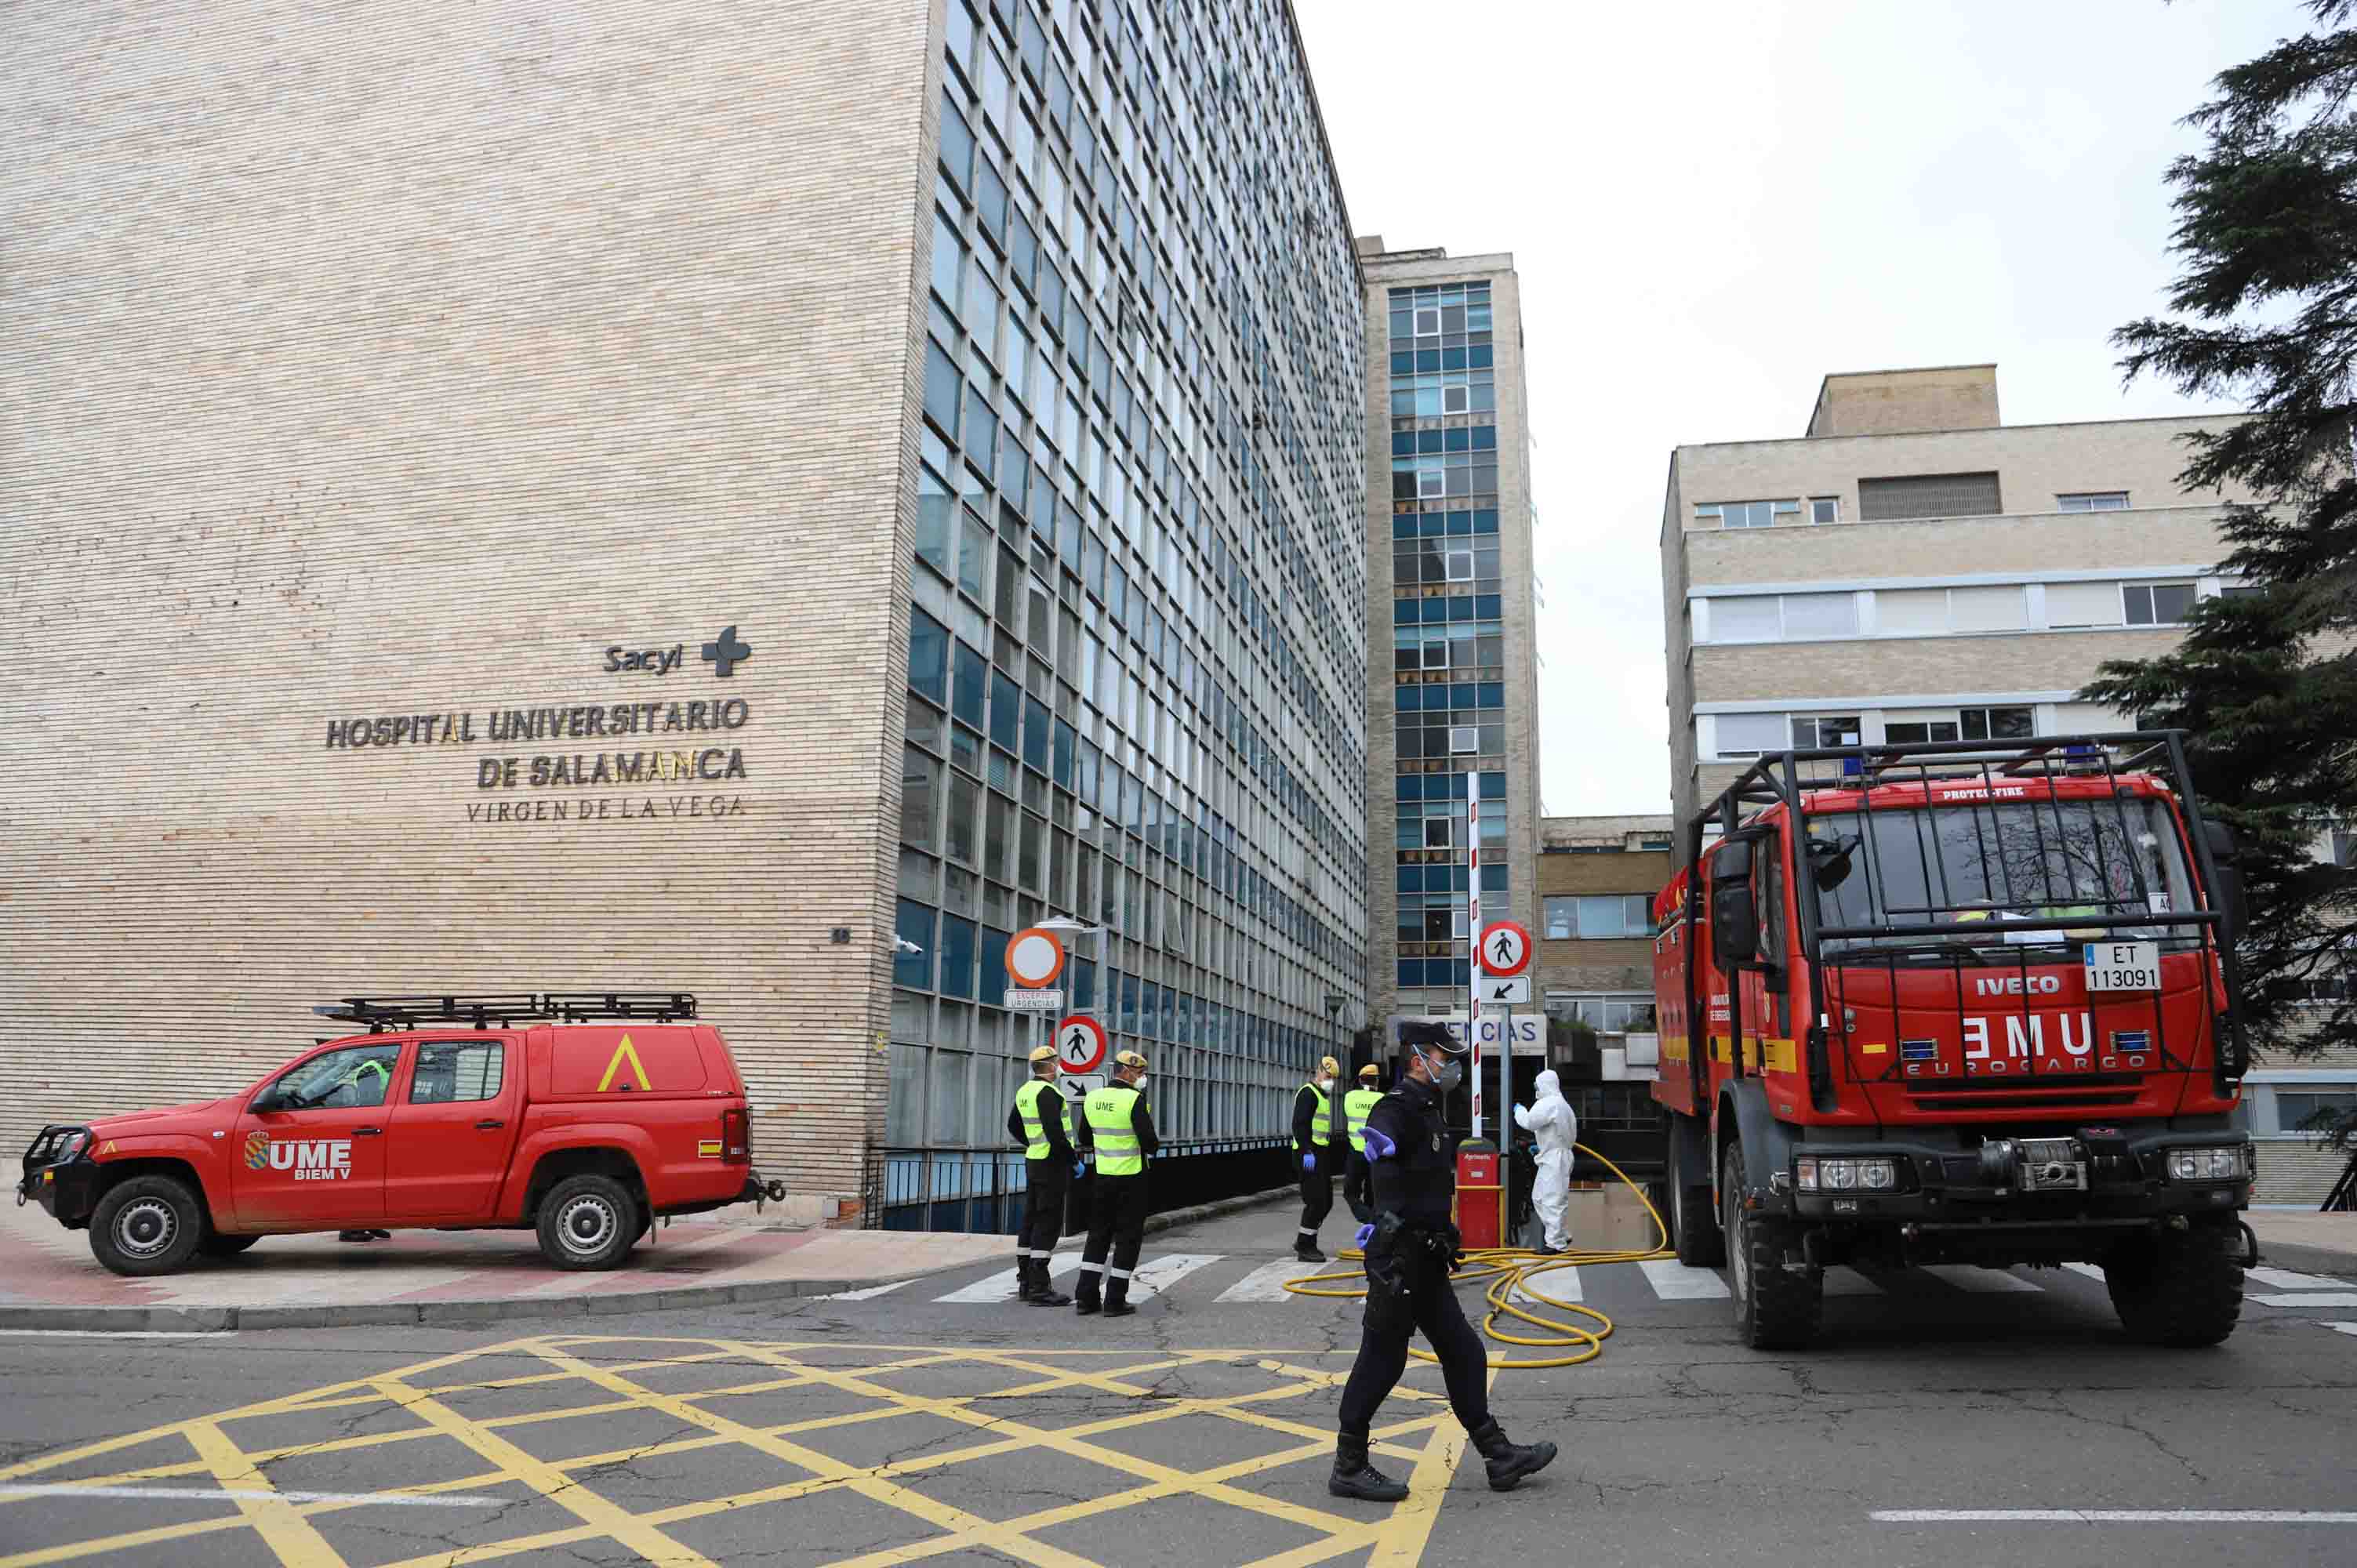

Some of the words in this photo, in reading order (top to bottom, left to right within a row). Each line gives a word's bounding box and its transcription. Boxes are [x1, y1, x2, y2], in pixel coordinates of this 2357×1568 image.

[603, 643, 684, 675] Sacyl
[325, 713, 475, 747] HOSPITAL
[487, 698, 749, 741] UNIVERSITARIO
[477, 757, 518, 788] DE
[528, 748, 747, 785] SALAMANCA
[467, 799, 572, 822] VIRGEN
[579, 798, 609, 820] DE
[620, 797, 656, 818] LA
[668, 795, 746, 817] VEGA
[2112, 946, 2137, 964] ET
[1976, 975, 2060, 996] IVECO
[2090, 969, 2157, 989] 113091
[1396, 1022, 1536, 1042] ECIAS
[1907, 1054, 2146, 1075] EUROCARGO
[1095, 1101, 1114, 1112] UME
[269, 1144, 352, 1170] UME
[294, 1169, 335, 1181] BIEM
[340, 1168, 351, 1180] V
